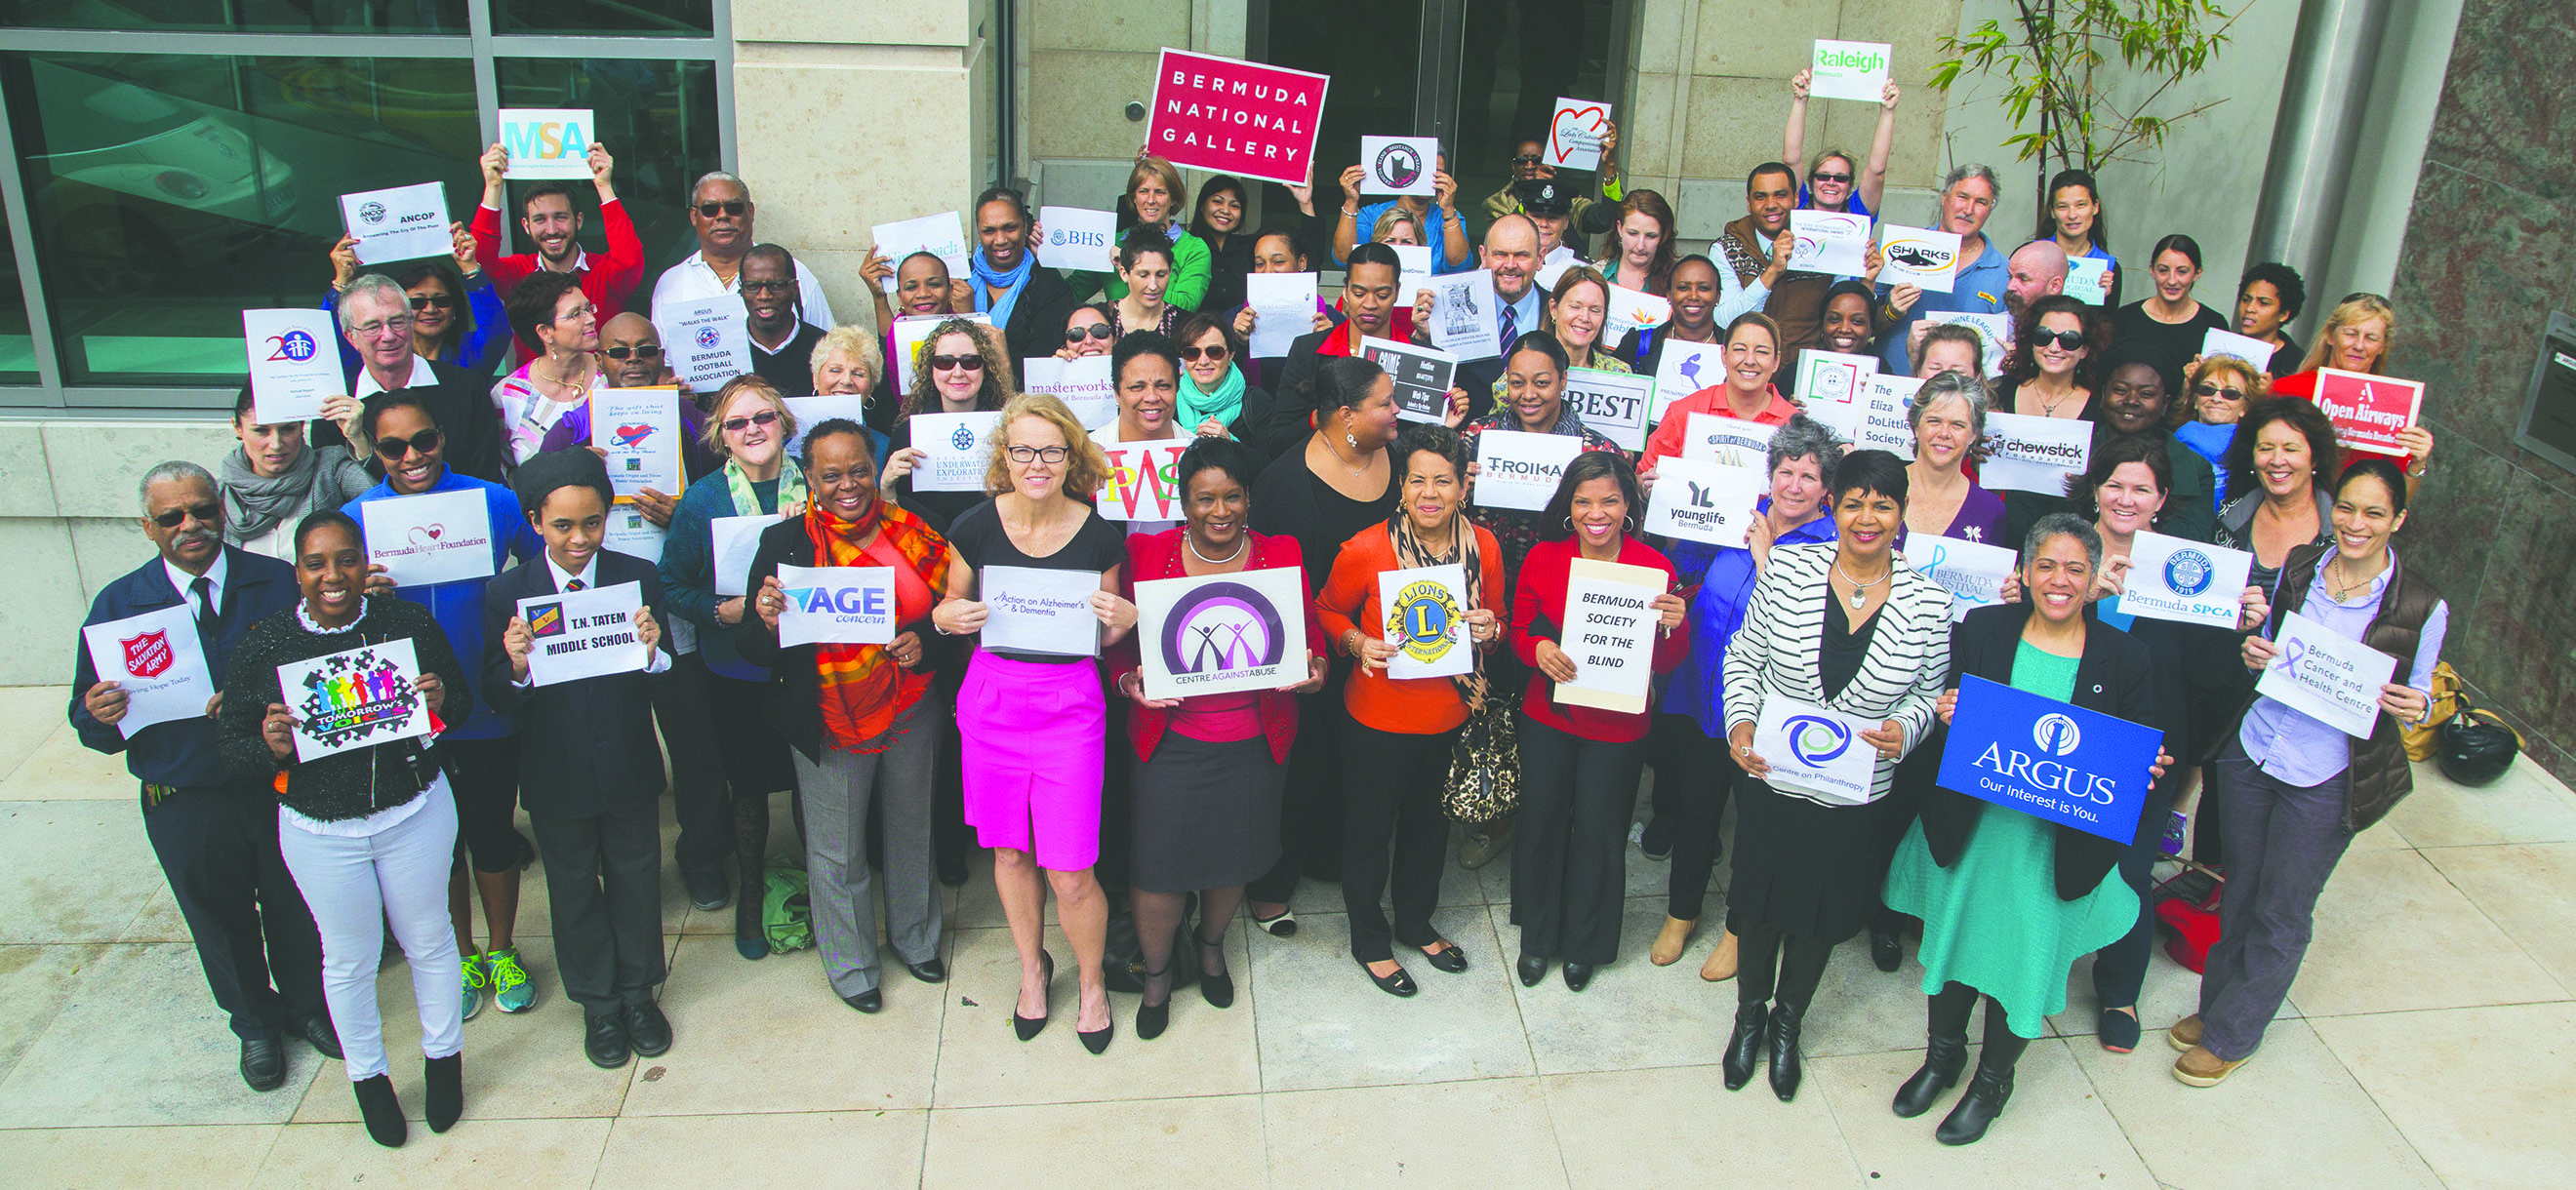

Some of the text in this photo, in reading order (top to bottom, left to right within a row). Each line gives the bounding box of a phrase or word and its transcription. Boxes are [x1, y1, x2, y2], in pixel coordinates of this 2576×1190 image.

[1816, 49, 1884, 73] Raleigh
[1173, 70, 1308, 106] BERMUDA
[1167, 99, 1303, 135] NATIONAL
[504, 122, 588, 159] MSA
[1162, 128, 1298, 161] GALLERY
[400, 212, 435, 223] ANCOP
[1068, 230, 1104, 247] BHS
[691, 350, 731, 362] BERMUDA
[693, 360, 733, 372] FOOTBALL
[689, 369, 741, 382] ASSOCIATION
[1031, 378, 1114, 393] masterworks
[1874, 384, 1892, 396] The
[1567, 390, 1641, 420] BEST
[1870, 400, 1893, 413] Eliza
[2321, 397, 2406, 431] Open Airways
[1868, 416, 1911, 430] DoLittle
[1737, 436, 1765, 452] BERMUDA
[1866, 431, 1906, 447] Society
[2007, 439, 2083, 458] chewstick
[1488, 456, 1563, 477] TROIKA
[2005, 452, 2082, 465] FOUNDATION
[937, 468, 986, 477] EXPLORATIO
[1486, 472, 1562, 484] BERMUDA
[1670, 508, 1725, 525] younglife
[1678, 520, 1713, 532] Bermuda
[2169, 551, 2211, 573] BERMUDA
[1936, 578, 1986, 596] FESTIVAL
[1937, 569, 1993, 588] BERMUDA
[1404, 584, 1445, 602] LIONS
[2175, 585, 2194, 595] 1919
[807, 587, 886, 615] AGE
[1001, 594, 1026, 605] Action
[1040, 598, 1084, 610] Alzheimer's
[1582, 593, 1644, 610] BERMUDA
[2127, 589, 2188, 612] Bermuda
[2192, 604, 2233, 617] SPCA
[836, 615, 886, 624] concern
[1021, 606, 1056, 616] Dementia
[571, 613, 626, 629] T.N. TATEM
[1415, 605, 1439, 638] L
[1587, 613, 1636, 628] SOCIETY
[130, 637, 148, 655] THE
[546, 632, 635, 656] MIDDLE SCHOOL
[1583, 633, 1634, 649] FOR THE
[128, 636, 166, 672] SALVATION
[146, 649, 167, 674] ARMY
[1588, 655, 1624, 668] BLIND
[2309, 645, 2355, 673] Bermuda
[128, 676, 191, 694] iving Hope Today
[2304, 659, 2363, 693] Cancer and
[2299, 673, 2333, 695] Health
[2336, 690, 2373, 714] Centre
[317, 706, 407, 732] VOICES
[1772, 765, 1800, 777] Centre
[1815, 773, 1865, 793] Philanthropy
[1971, 741, 2116, 806] ARGUS
[1980, 776, 2099, 823] Our Interest is You.
